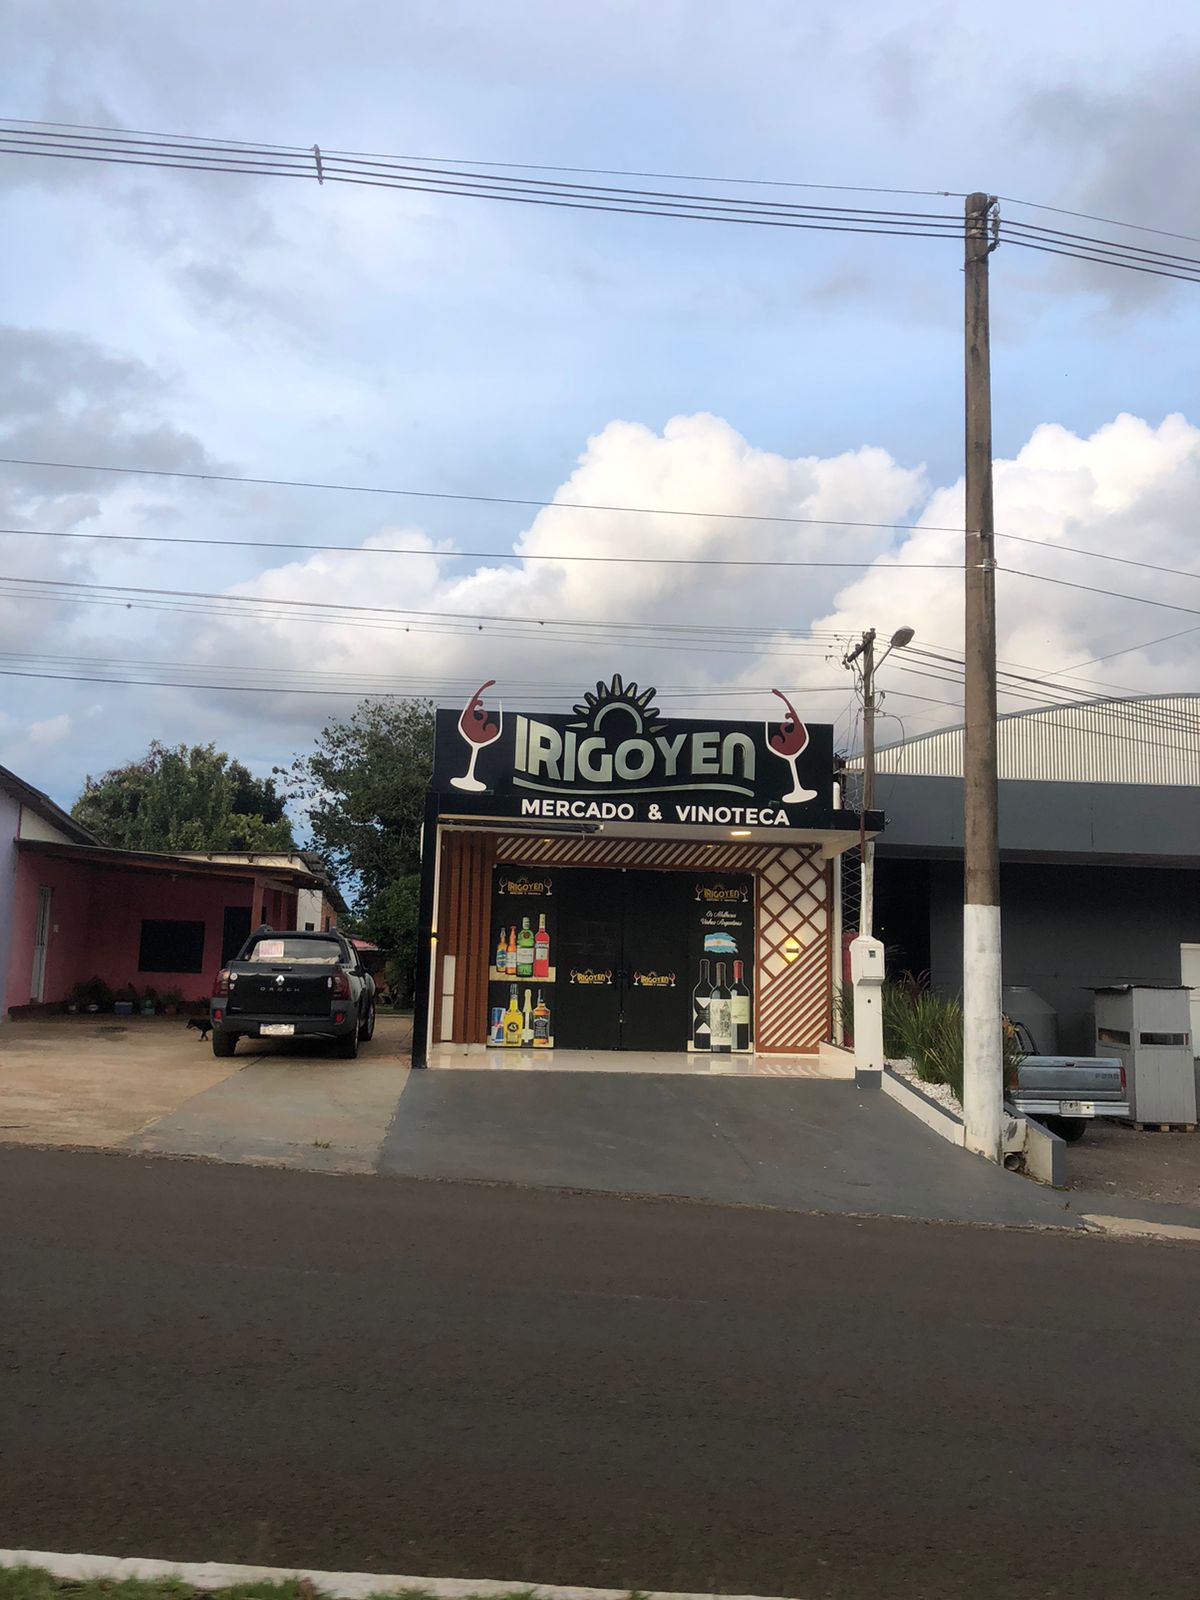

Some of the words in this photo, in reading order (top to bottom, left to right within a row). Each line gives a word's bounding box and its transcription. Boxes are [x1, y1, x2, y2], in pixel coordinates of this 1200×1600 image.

[515, 714, 756, 783] IRIGOYEN
[521, 798, 634, 821] MERCADO
[648, 804, 663, 821] &
[676, 804, 790, 826] VINOTECA
